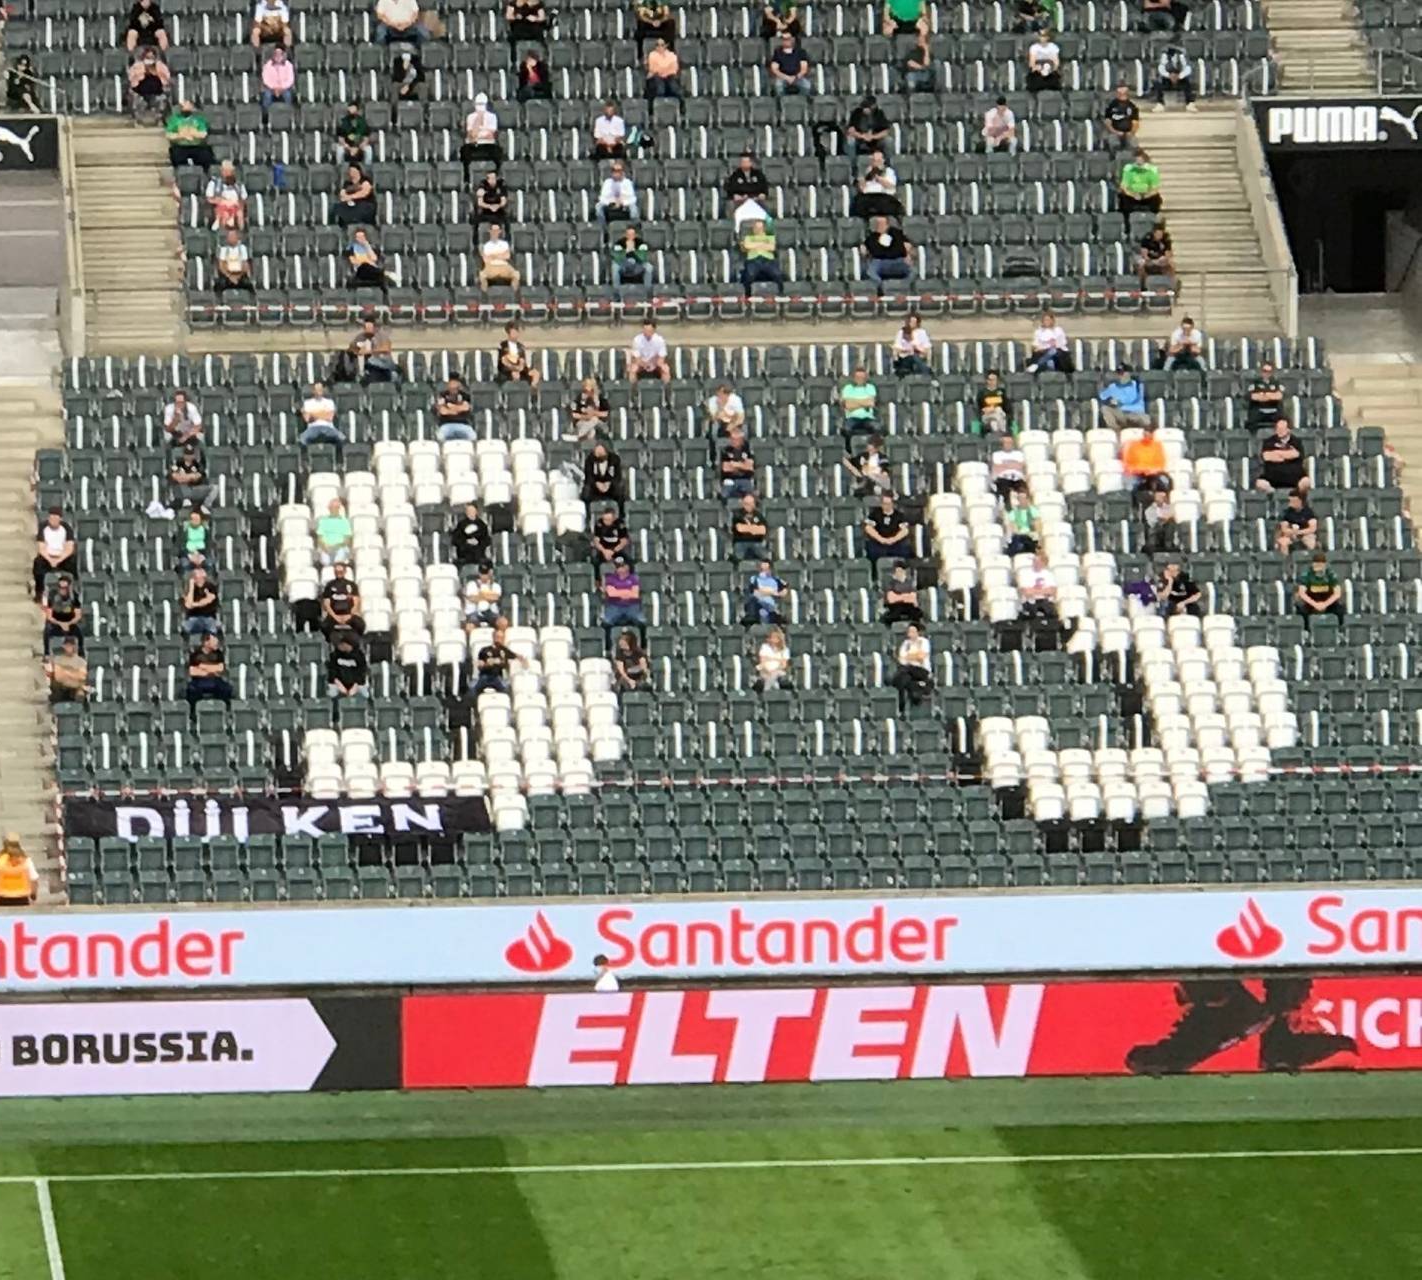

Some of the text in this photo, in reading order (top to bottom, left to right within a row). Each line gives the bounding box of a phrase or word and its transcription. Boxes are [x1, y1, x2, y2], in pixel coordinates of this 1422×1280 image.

[596, 905, 959, 969] Santander
[11, 1031, 255, 1066] BORUSSIA.
[526, 984, 1046, 1087] ELTEN
